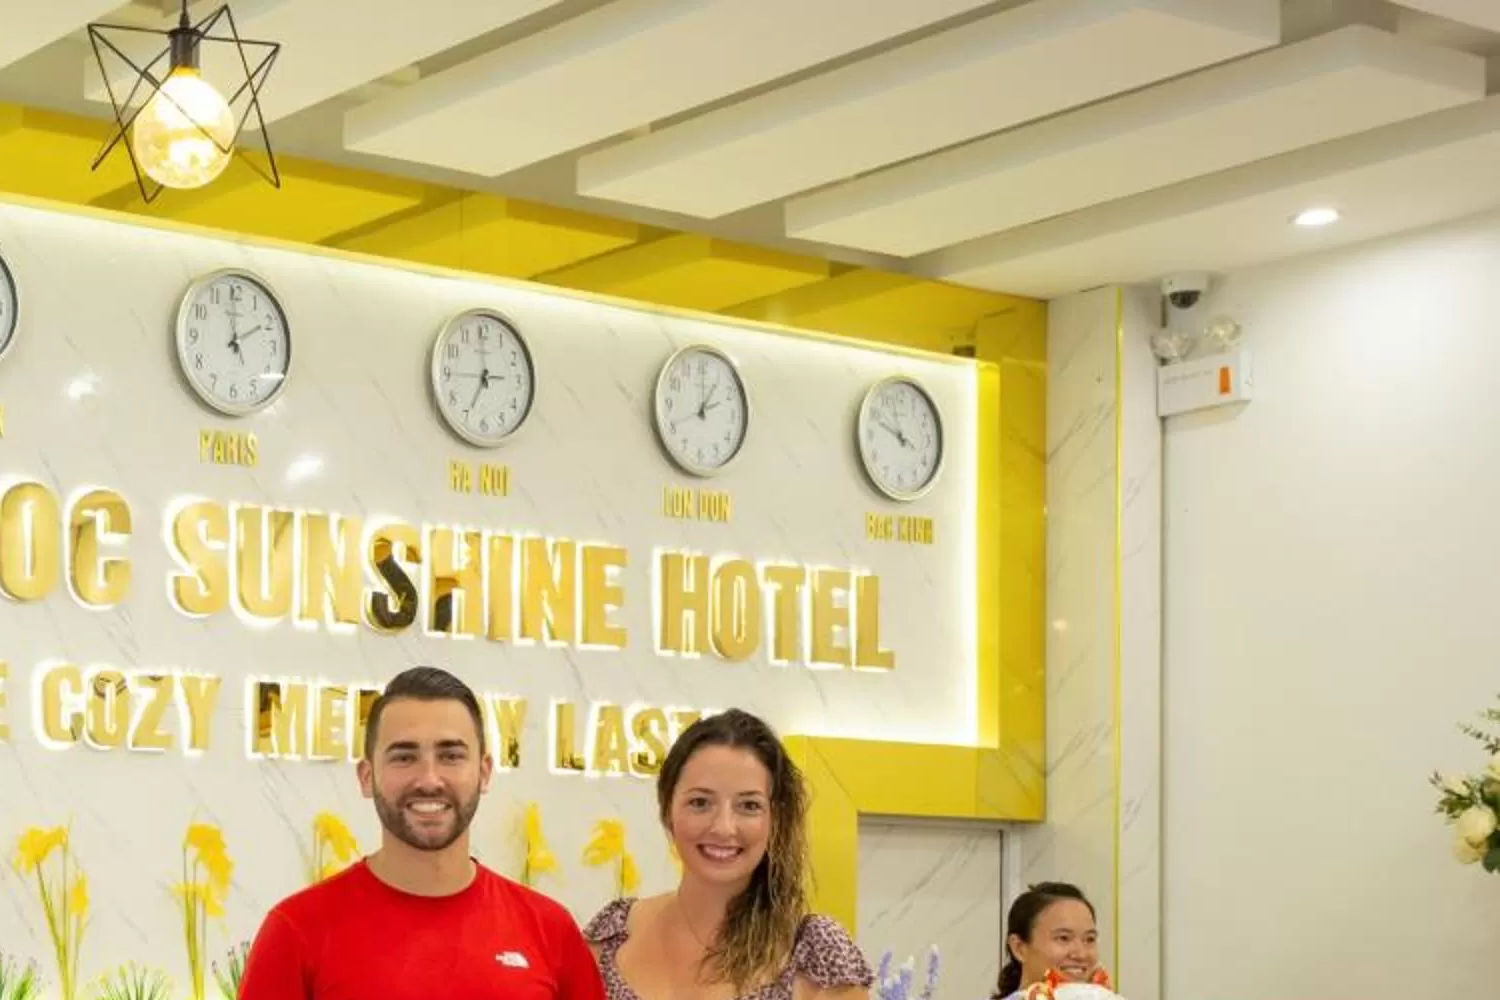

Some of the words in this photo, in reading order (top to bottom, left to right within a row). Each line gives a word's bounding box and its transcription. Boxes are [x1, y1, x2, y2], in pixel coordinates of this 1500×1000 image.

[199, 430, 257, 467] PARIS
[449, 459, 472, 495] HA
[479, 463, 510, 497] NOI
[169, 499, 628, 649] SUNSHINE
[656, 550, 896, 672] HOTEL
[40, 664, 223, 752] COZY
